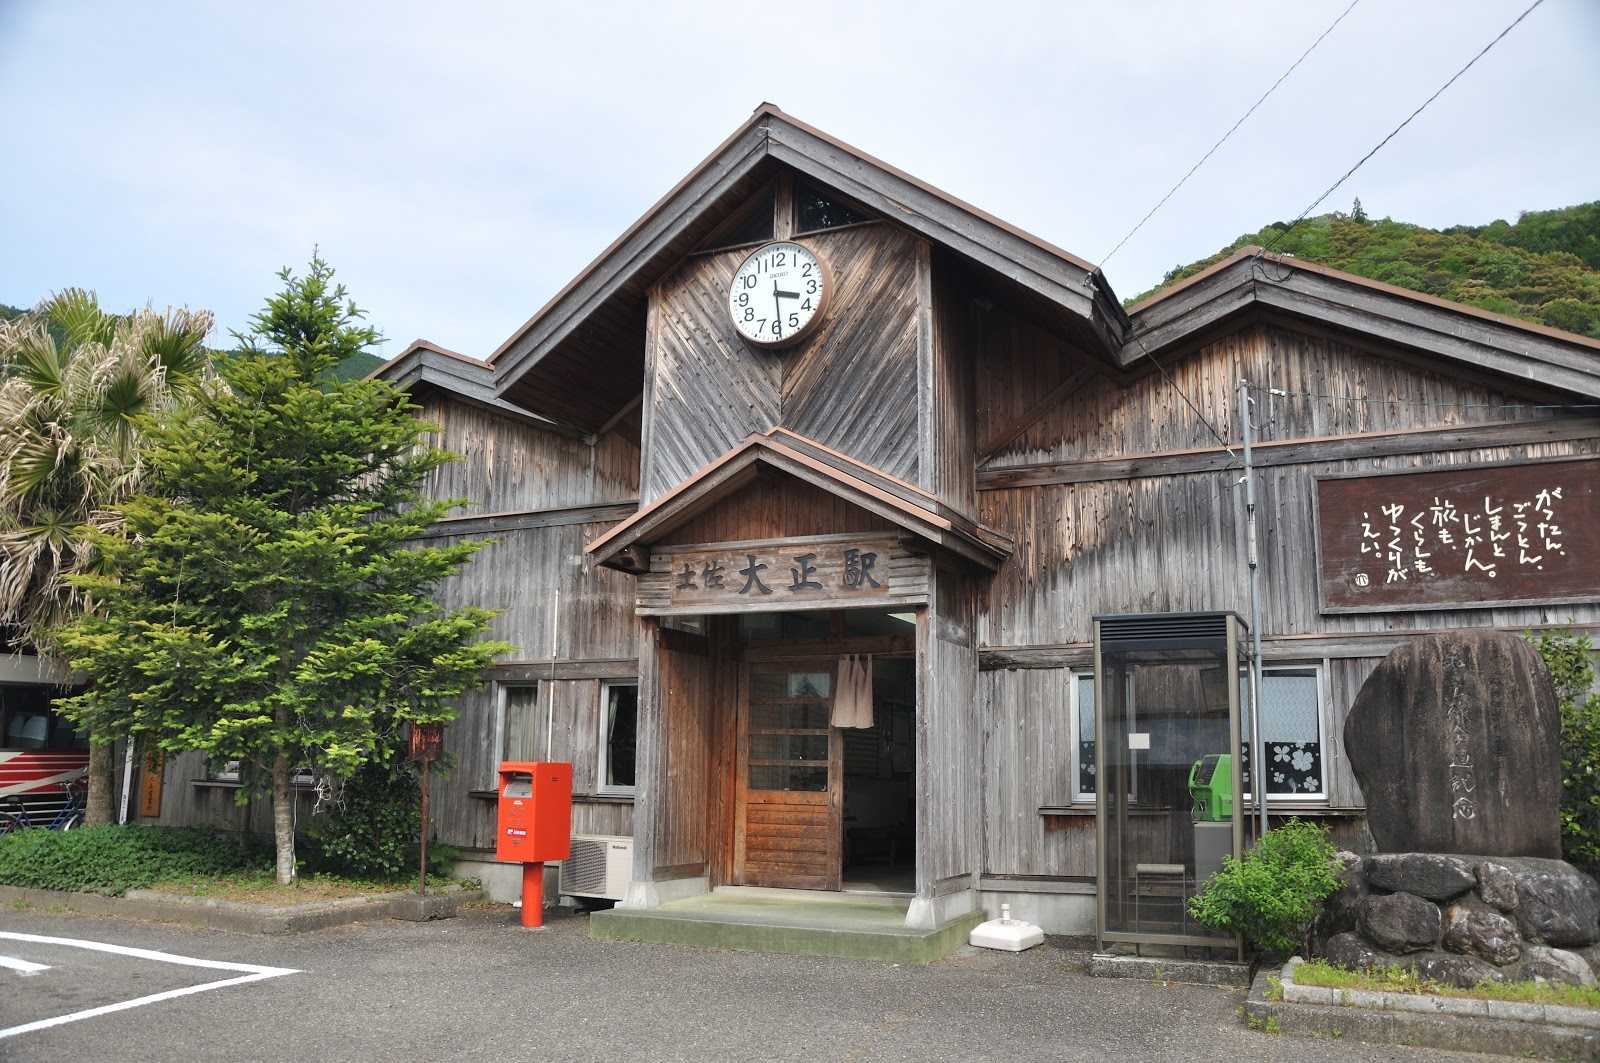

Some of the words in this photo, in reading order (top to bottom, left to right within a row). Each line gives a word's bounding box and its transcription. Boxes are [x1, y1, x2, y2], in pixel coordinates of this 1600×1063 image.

[757, 259, 768, 274] 11
[771, 252, 786, 268] 12
[793, 253, 797, 268] 1
[802, 262, 812, 278] 2
[743, 274, 757, 289] 10
[806, 279, 817, 294] 3
[738, 292, 749, 307] 9
[800, 297, 812, 312] 4
[744, 307, 755, 322] 8
[788, 312, 799, 327] 5
[756, 318, 767, 333] 7
[771, 319, 782, 335] 6
[1485, 496, 1511, 557] しまんと
